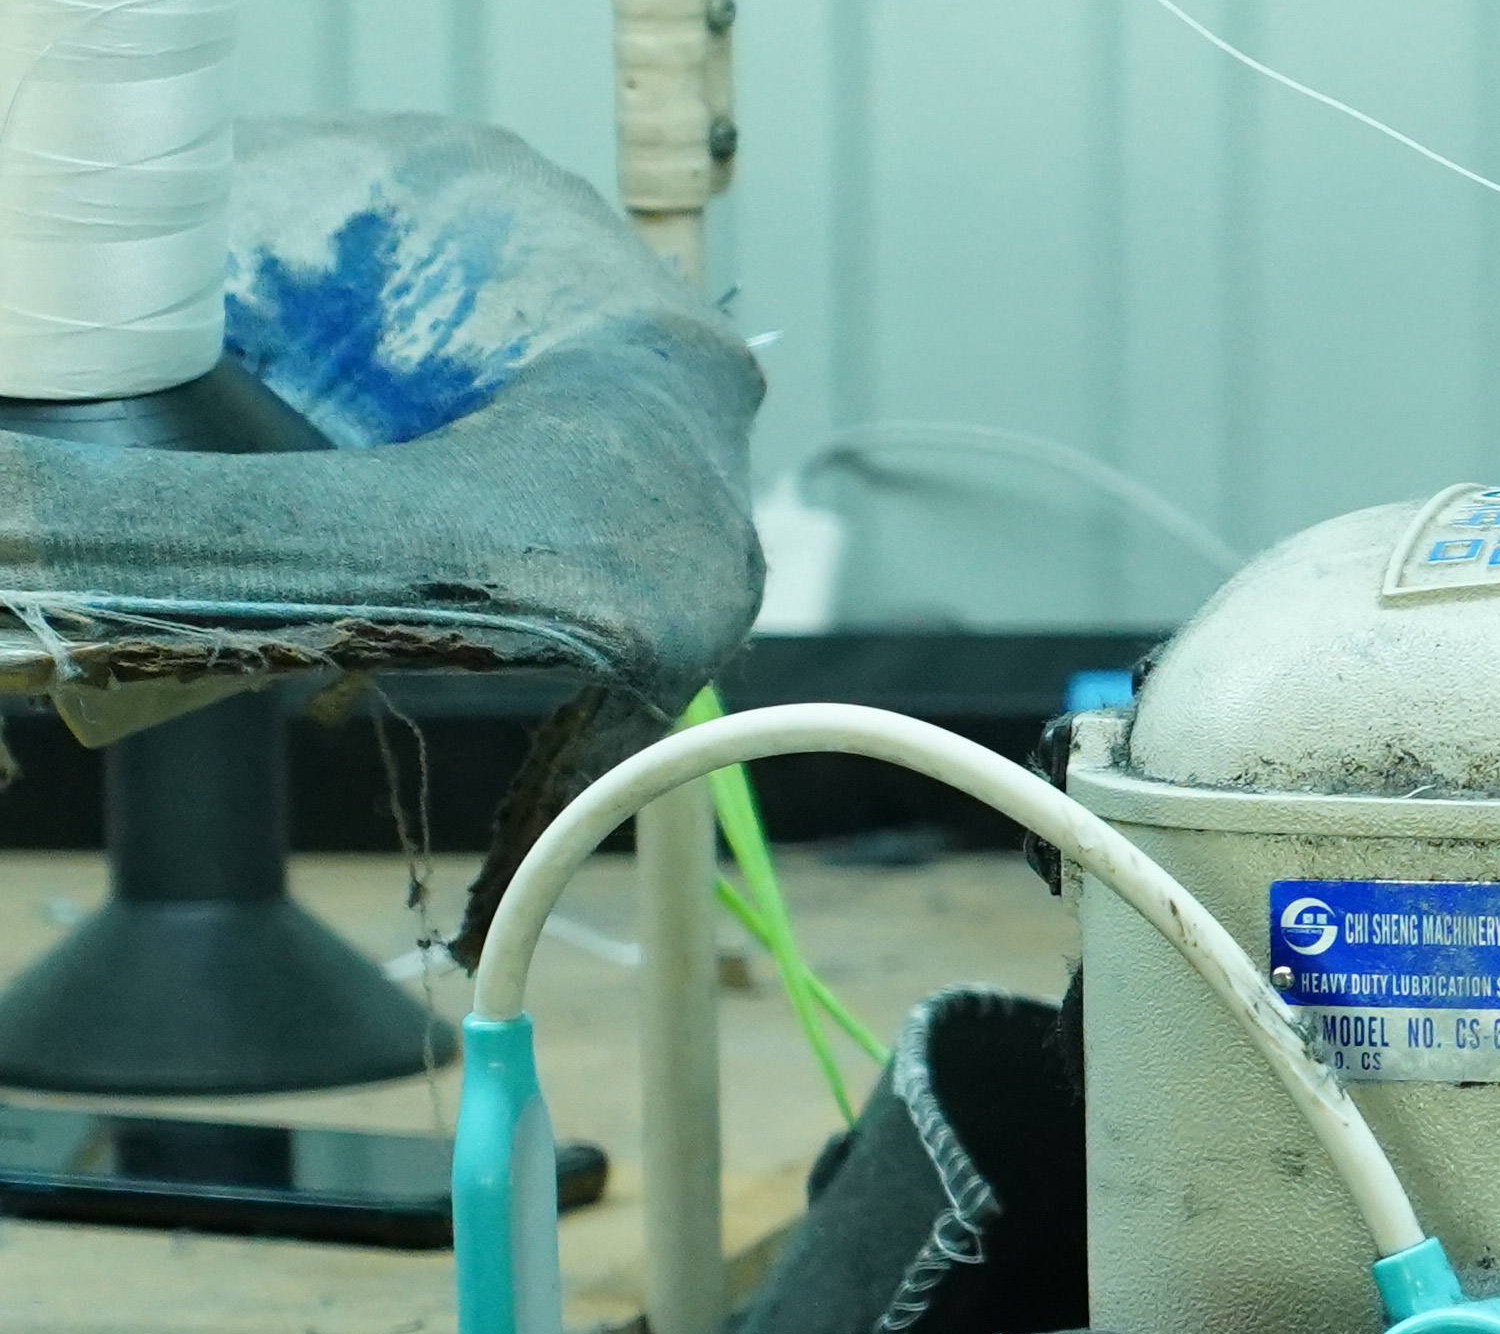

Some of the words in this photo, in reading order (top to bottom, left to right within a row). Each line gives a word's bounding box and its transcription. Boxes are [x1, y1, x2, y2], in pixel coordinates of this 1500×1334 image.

[1344, 912, 1369, 944] CHI
[1372, 912, 1419, 946] SHENG
[1301, 972, 1347, 994] HEAVY
[1351, 973, 1389, 996] DUTY
[1391, 974, 1492, 998] LUBRICATION
[1321, 1014, 1390, 1048] MODEL
[1407, 1016, 1442, 1049] NO.
